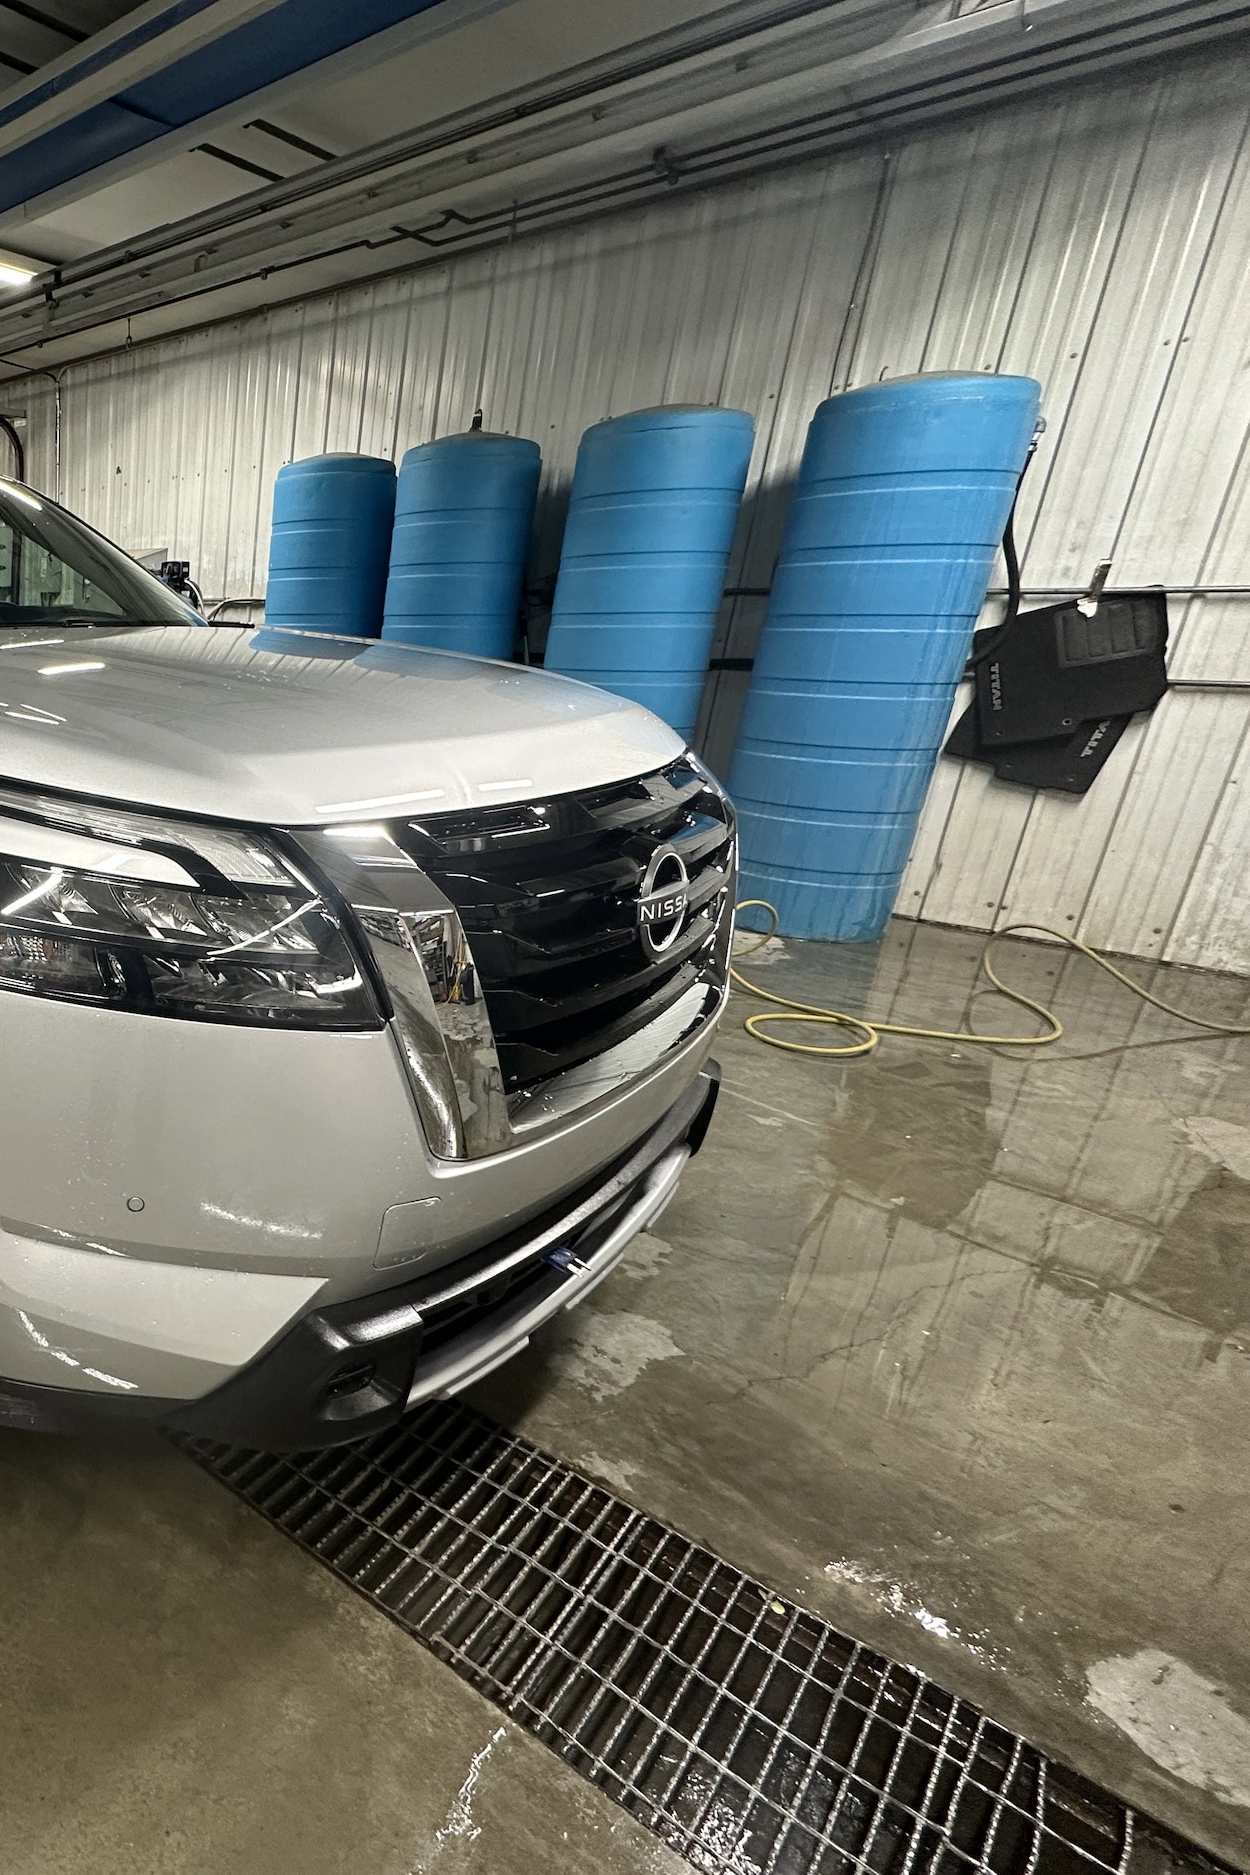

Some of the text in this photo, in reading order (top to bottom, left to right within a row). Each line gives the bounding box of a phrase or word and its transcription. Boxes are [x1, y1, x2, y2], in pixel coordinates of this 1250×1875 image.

[990, 662, 1002, 711] TITAN
[1080, 720, 1111, 758] TITA
[640, 894, 687, 922] NISS
